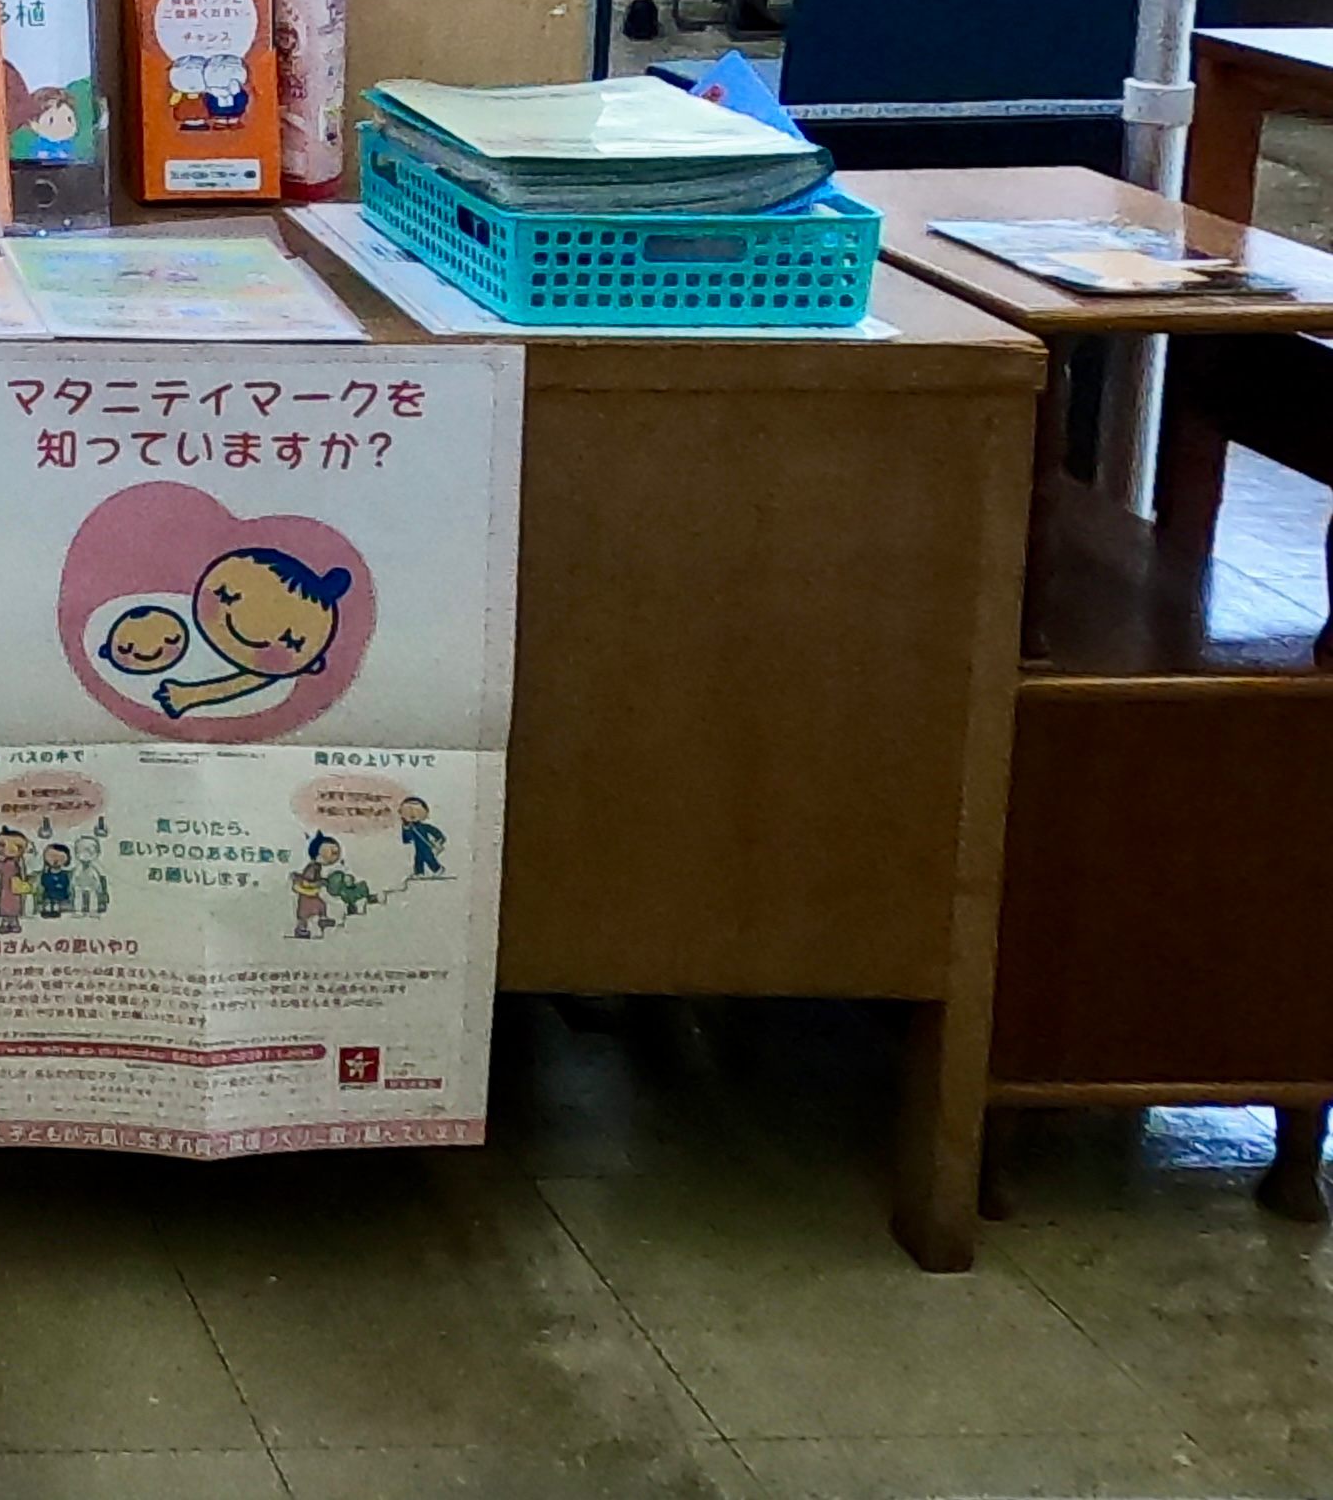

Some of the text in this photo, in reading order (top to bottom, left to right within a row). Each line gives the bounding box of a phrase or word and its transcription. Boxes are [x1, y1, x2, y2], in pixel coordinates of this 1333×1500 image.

[7, 376, 427, 419] マタニティマークを
[36, 428, 394, 471] 知っていますか?
